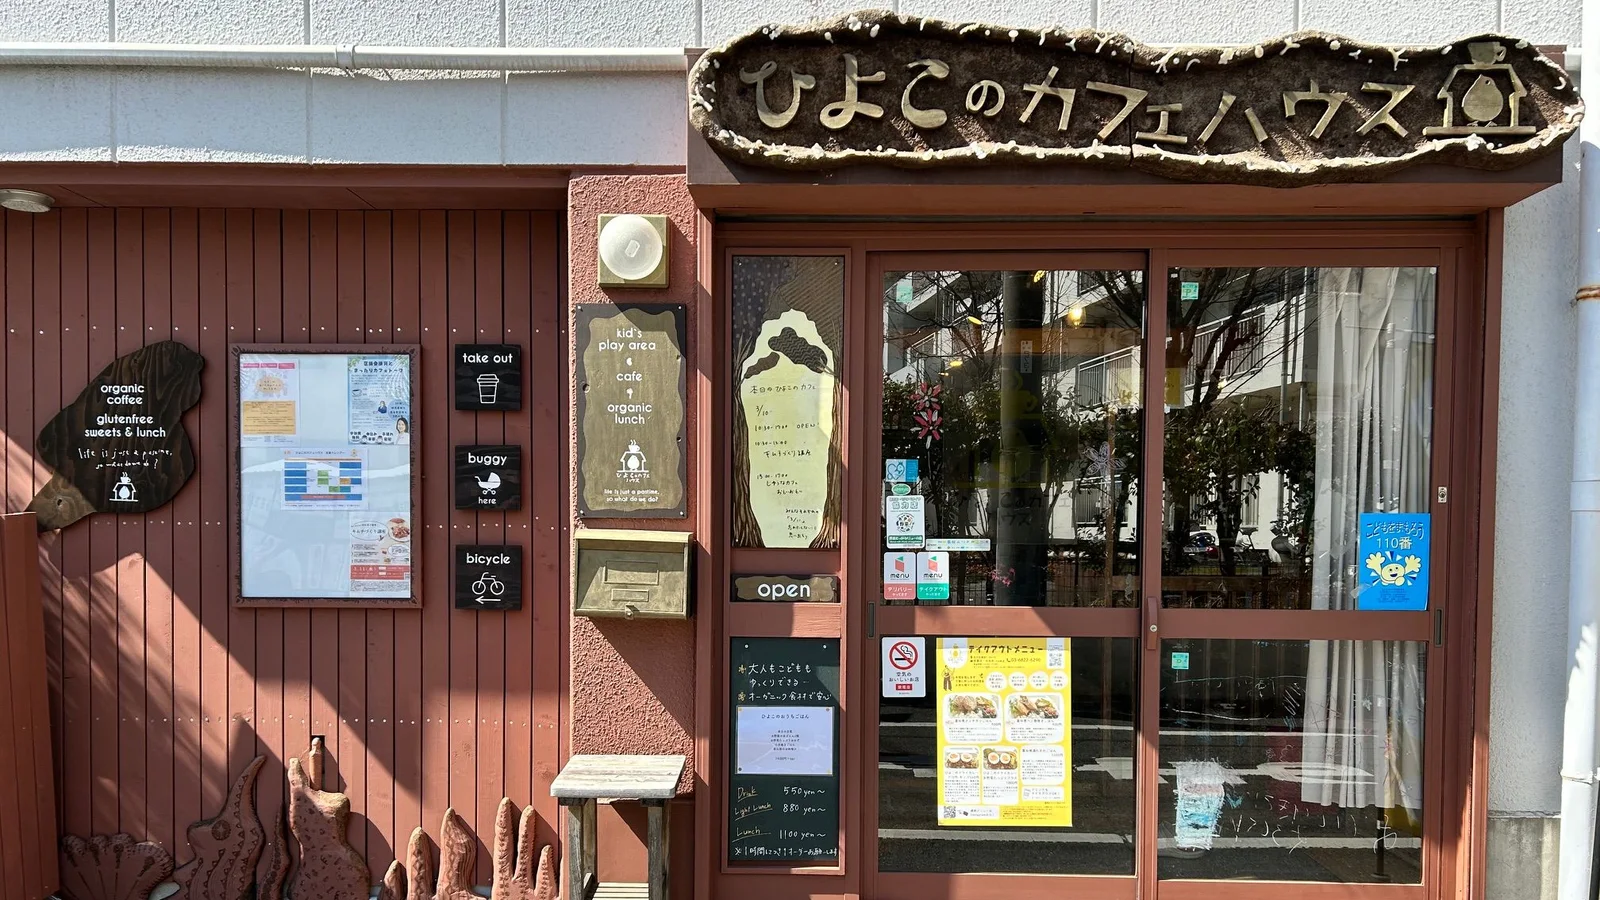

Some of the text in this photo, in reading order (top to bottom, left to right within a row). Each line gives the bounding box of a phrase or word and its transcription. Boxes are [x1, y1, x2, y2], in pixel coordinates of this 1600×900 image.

[738, 51, 1415, 146] ひよこのカフェハウス
[598, 338, 656, 352] play area
[462, 352, 513, 364] take out
[616, 370, 643, 382] cafe
[100, 384, 145, 394] organic
[106, 394, 143, 405] coffee
[607, 402, 653, 414] organic
[96, 413, 154, 426] glutenfree
[614, 413, 646, 424] lunch
[84, 426, 166, 438] sweets & lunch
[78, 448, 96, 459] life
[101, 448, 108, 458] is
[111, 448, 130, 460] just
[467, 452, 508, 466] buggy
[478, 496, 497, 505] here
[1366, 522, 1424, 540] こどもをまもろう
[1376, 536, 1413, 550] 110番
[466, 552, 511, 566] bicycle
[757, 583, 811, 600] open
[968, 645, 1044, 654] テイクアウトメニュー
[748, 662, 812, 675] 大人もこどもも
[737, 786, 757, 800] Drink
[783, 786, 802, 796] 550
[782, 803, 800, 812] 880
[736, 826, 761, 837] Lunch
[779, 829, 798, 840] 1100
